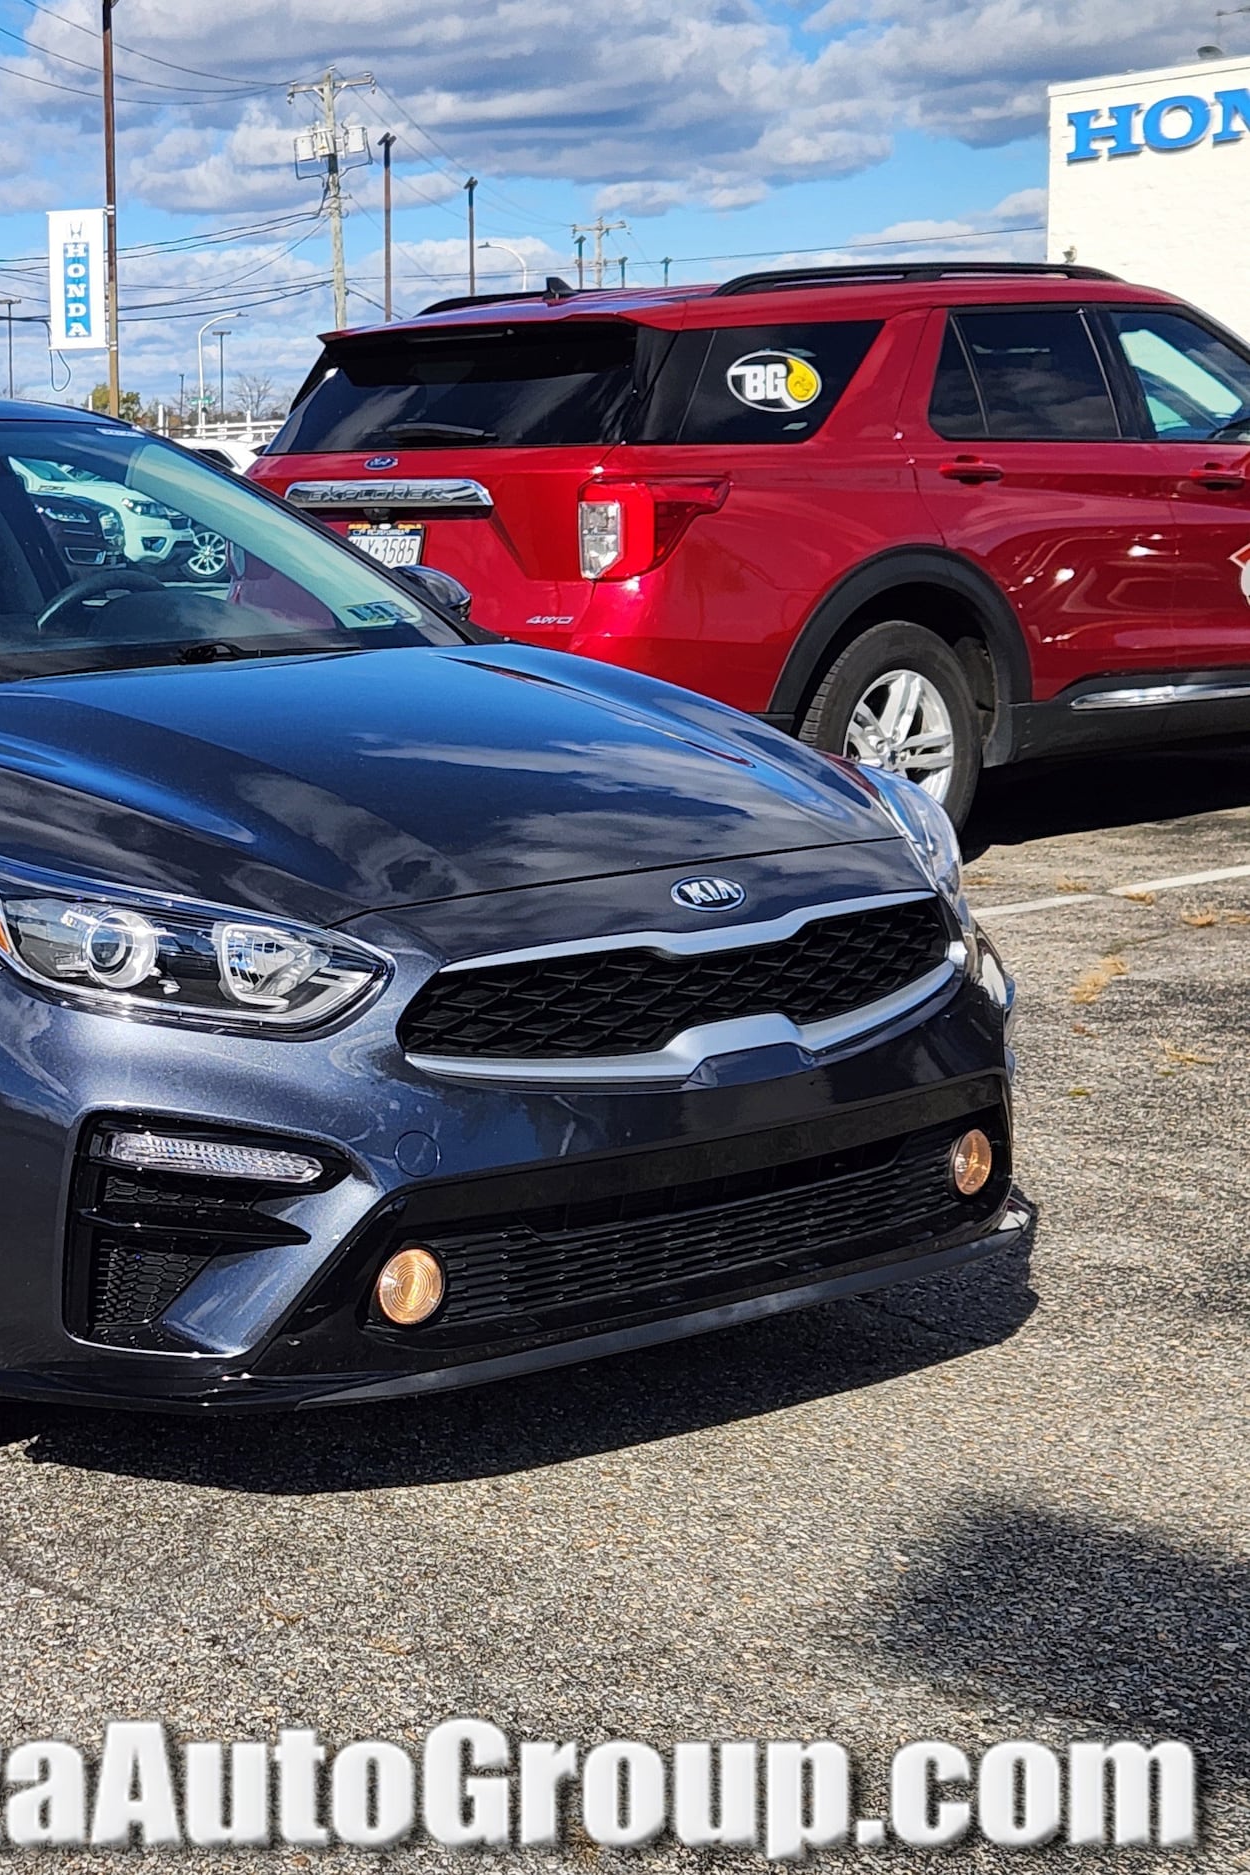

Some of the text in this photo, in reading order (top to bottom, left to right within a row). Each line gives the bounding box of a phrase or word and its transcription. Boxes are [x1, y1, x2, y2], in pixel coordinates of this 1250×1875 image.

[65, 243, 89, 337] HONDA
[735, 363, 788, 401] BG
[309, 486, 446, 501] EXPLORER
[526, 615, 574, 624] 4WD
[680, 879, 739, 904] KIA
